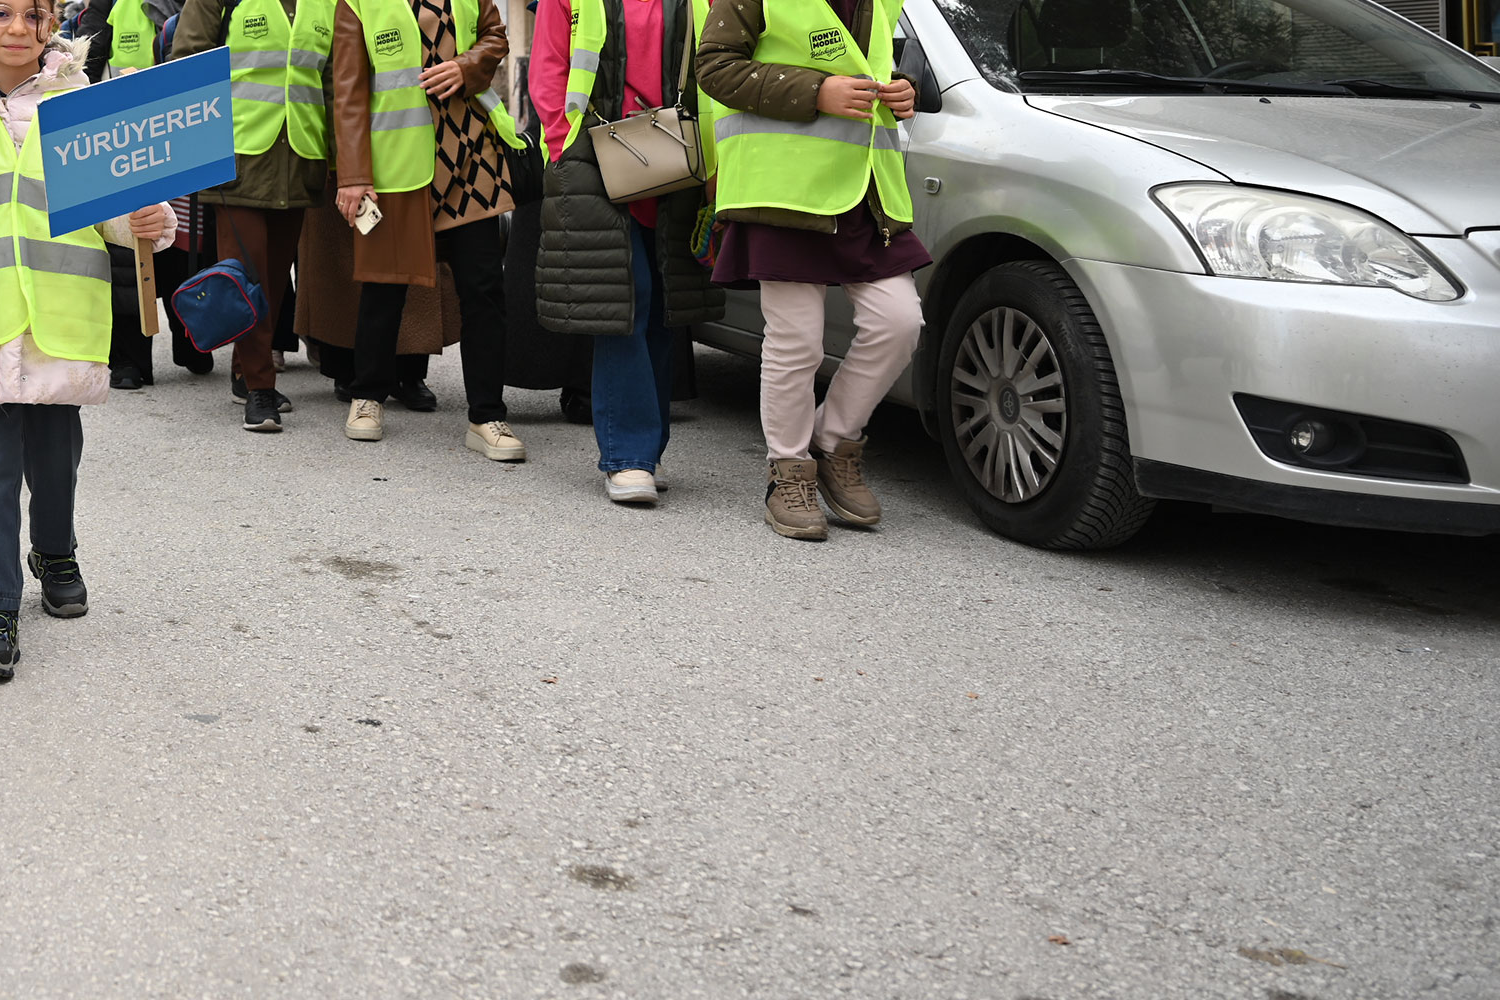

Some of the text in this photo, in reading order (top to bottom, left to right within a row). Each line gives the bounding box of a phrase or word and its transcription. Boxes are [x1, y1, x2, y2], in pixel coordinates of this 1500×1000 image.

[376, 30, 399, 41] KONYA
[812, 30, 840, 42] KONYA
[53, 97, 222, 166] YÜRÜYEREK
[110, 140, 171, 177] GEL!
